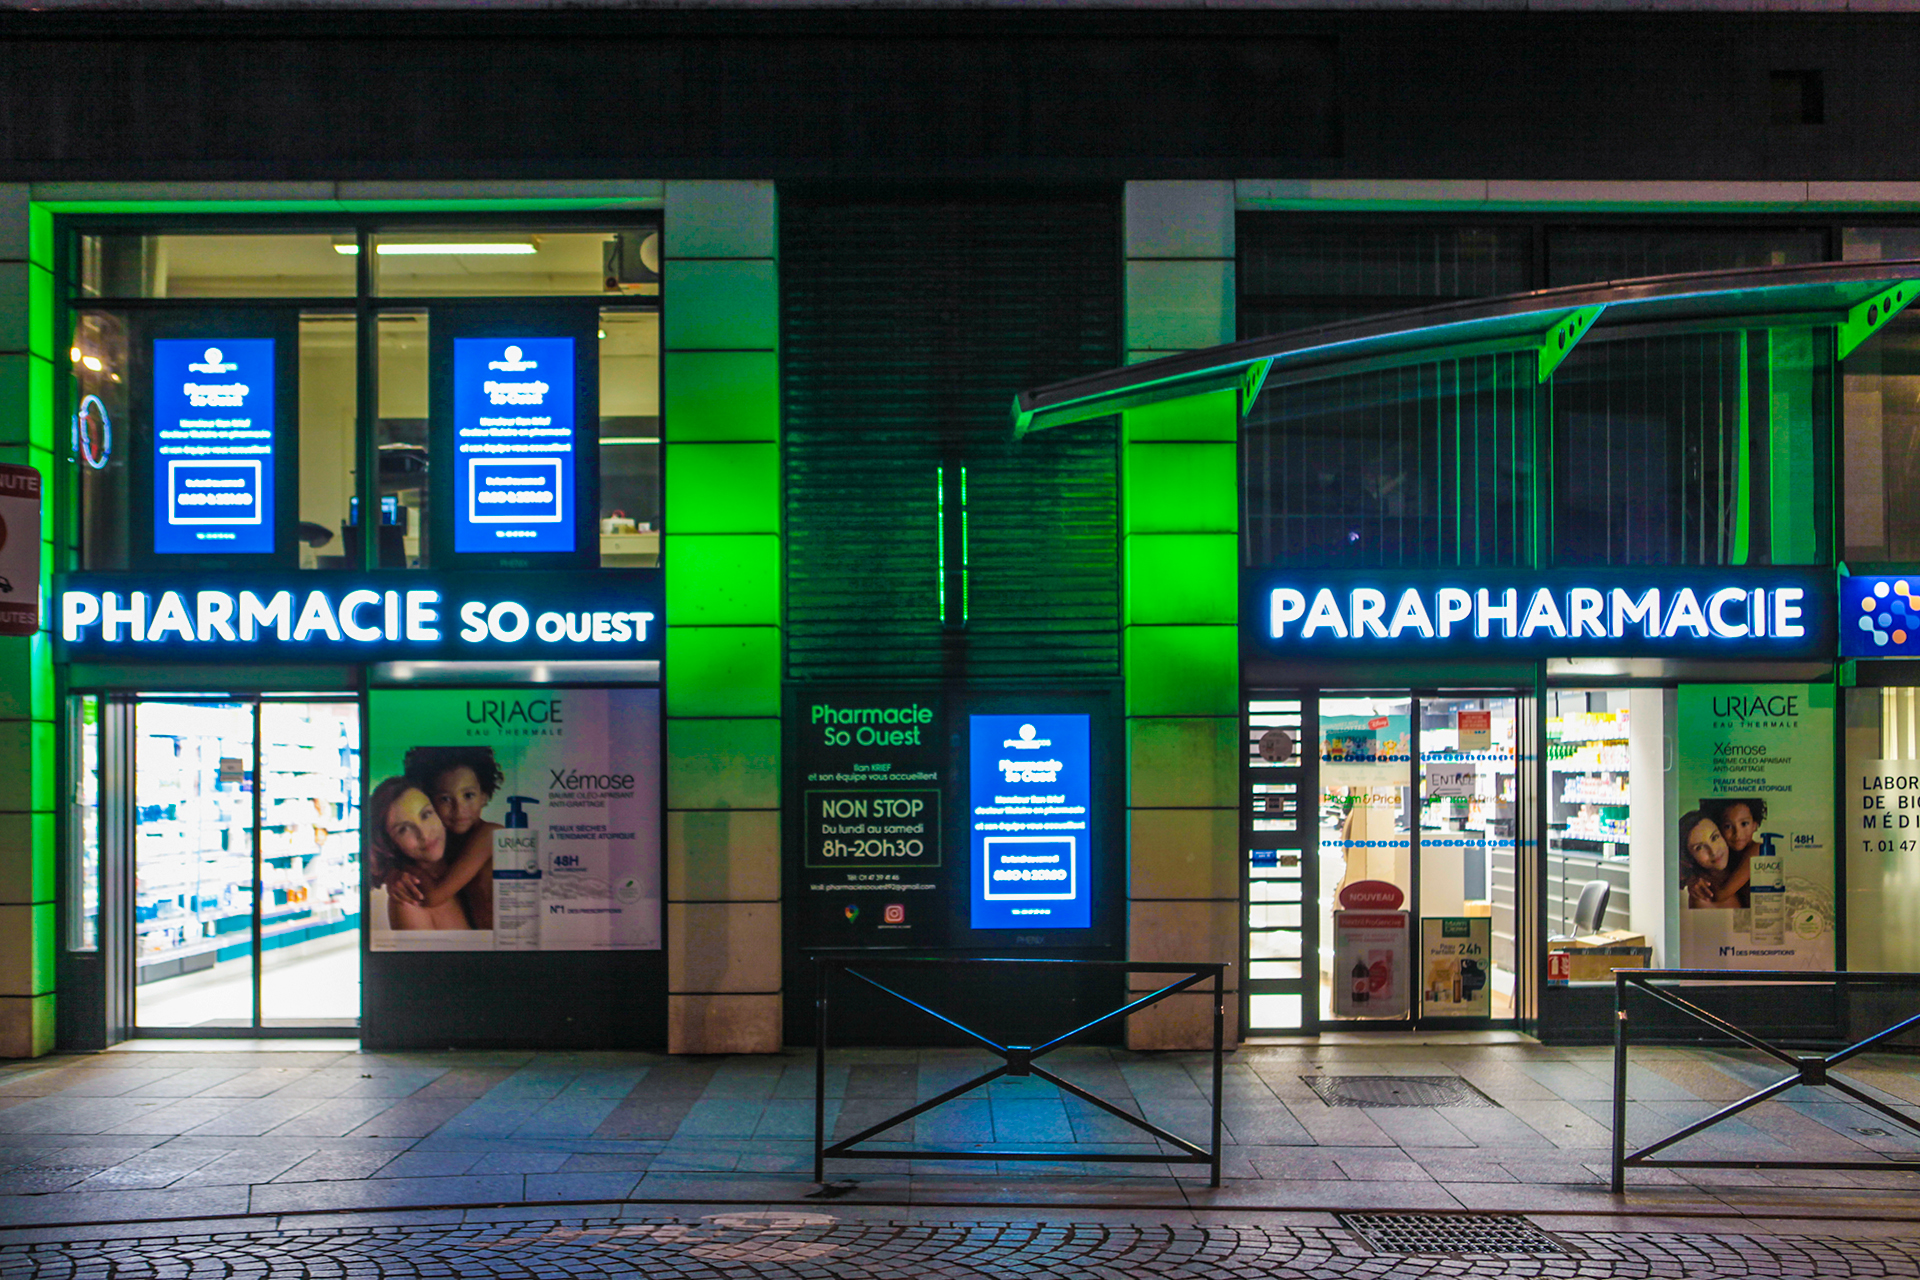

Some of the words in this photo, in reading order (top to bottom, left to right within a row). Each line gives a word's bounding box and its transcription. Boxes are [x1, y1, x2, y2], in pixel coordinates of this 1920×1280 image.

[0, 611, 36, 625] UTES
[61, 589, 440, 642] PHARMACIE
[460, 602, 529, 642] SO
[535, 612, 655, 642] OUEST
[1271, 587, 1805, 638] PARAPHARMACIE
[466, 700, 563, 728] URIAGE
[811, 703, 933, 724] Pharmacie
[1713, 696, 1799, 721] URIAGE
[824, 726, 851, 746] So
[856, 725, 921, 746] Ouest
[1713, 742, 1767, 756] Xémose
[549, 769, 635, 790] Xémose
[807, 773, 818, 782] et
[835, 772, 867, 783] équipe
[889, 772, 938, 781] accueillent
[1862, 776, 1920, 790] LABOR
[1720, 784, 1757, 792] TENDANCE
[1758, 784, 1793, 792] ATOPIQUE
[822, 799, 868, 818] NON
[872, 799, 924, 818] STOP
[1863, 796, 1885, 809] DE
[1898, 796, 1920, 809] BI
[1862, 811, 1920, 829] MÉDI
[822, 824, 837, 834] Du
[838, 823, 865, 834] lundi
[884, 824, 924, 834] samedi
[498, 837, 536, 849] URIAGE
[1794, 835, 1815, 844] 48H
[1862, 840, 1874, 852] T.
[1878, 840, 1895, 852] 01
[1899, 840, 1917, 852] 47
[822, 839, 924, 857] 8h-20h30
[553, 855, 579, 866] 48H
[1349, 893, 1395, 902] NOUVEAU
[1459, 943, 1482, 955] 24h
[1719, 946, 1735, 957] N°1
